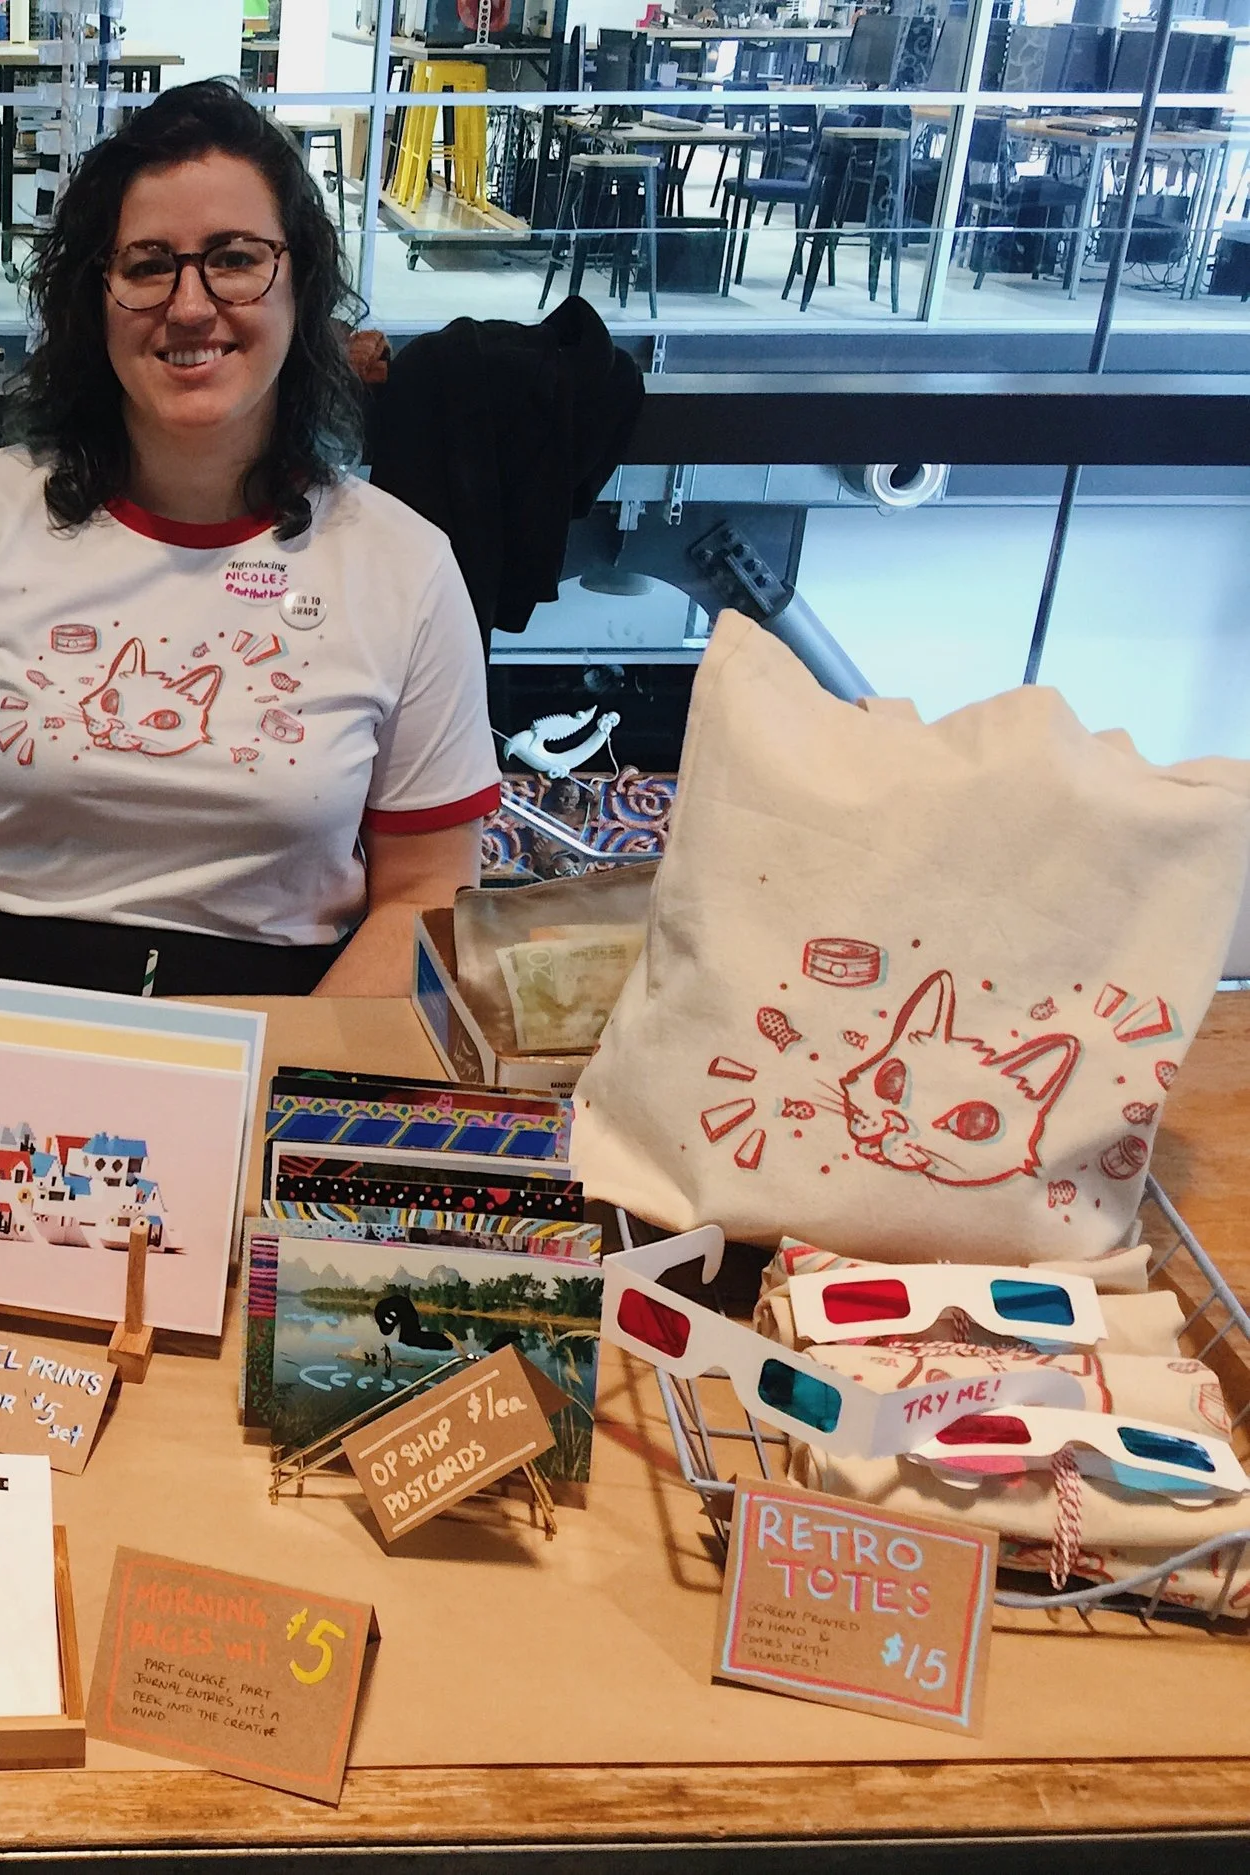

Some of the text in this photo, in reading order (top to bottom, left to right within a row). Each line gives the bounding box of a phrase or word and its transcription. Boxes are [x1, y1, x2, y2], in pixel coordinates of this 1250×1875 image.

[225, 571, 277, 584] NICOLE
[26, 1355, 104, 1397] PRINTS
[30, 1391, 63, 1426] $5
[903, 1379, 1001, 1424] TRY ME!
[47, 1423, 84, 1448] set
[370, 1450, 398, 1487] OP
[400, 1417, 451, 1467] SHOP
[382, 1440, 487, 1519] POSTCARDS
[758, 1505, 923, 1571] RETRO
[767, 1559, 931, 1618] TOTES
[130, 1620, 214, 1657] PAGES
[134, 1580, 346, 1685] MORNING $5
[768, 1620, 807, 1637] HAND
[802, 1611, 861, 1633] PRINTED
[791, 1641, 829, 1657] WITH
[881, 1632, 947, 1690] $15
[133, 1671, 184, 1695] JOURNAL
[143, 1658, 176, 1674] PART
[239, 1683, 274, 1700] PART
[132, 1690, 163, 1707] PEEK
[166, 1702, 193, 1714] INTO
[197, 1709, 219, 1722] THE
